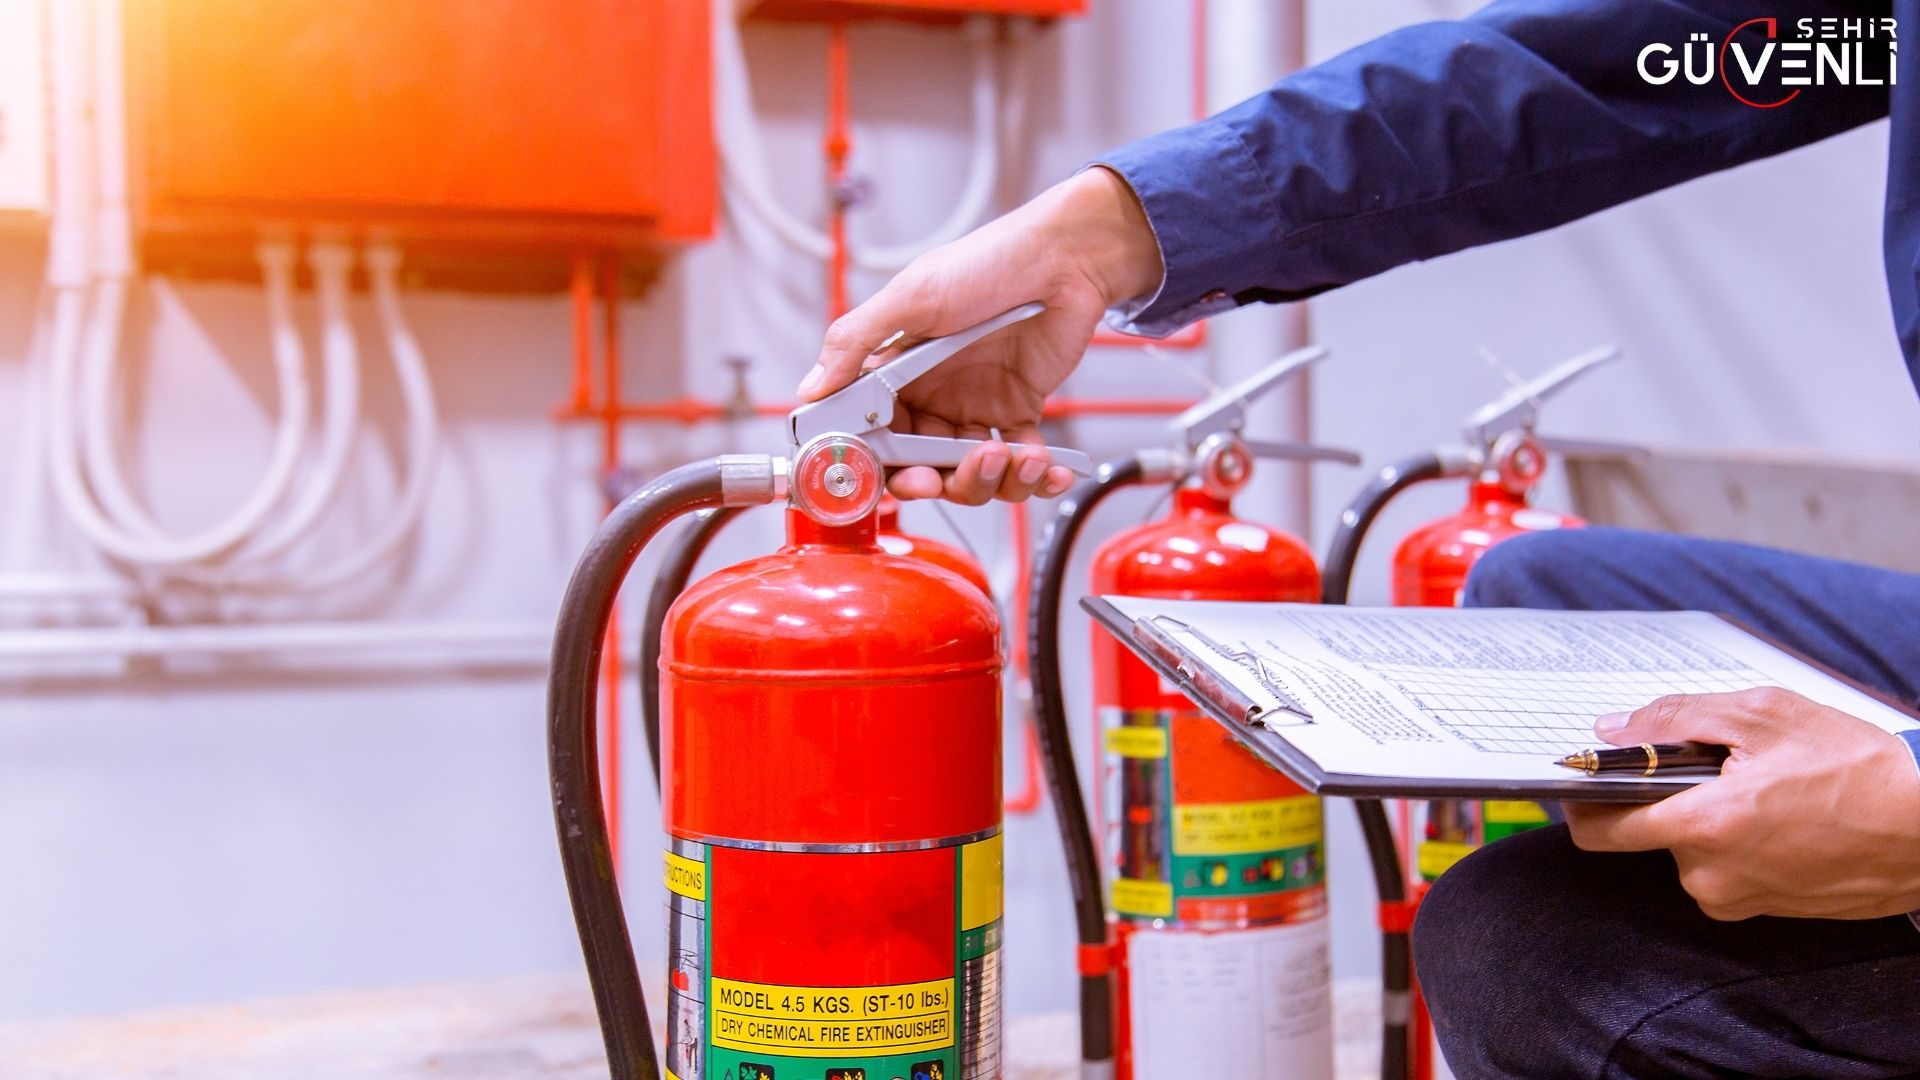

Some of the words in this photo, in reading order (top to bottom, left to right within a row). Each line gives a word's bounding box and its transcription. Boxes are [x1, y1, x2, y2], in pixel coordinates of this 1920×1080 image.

[720, 987, 775, 1011] MODEL
[781, 995, 805, 1012] 4.5
[813, 996, 854, 1013] KGS.
[863, 993, 915, 1017] (ST-10
[921, 987, 949, 1008] lbs.)
[721, 1017, 744, 1035] DRY
[747, 1022, 815, 1042] CHEMICAL
[820, 1027, 850, 1042] FIRE
[856, 1018, 946, 1042] EXTINGUISHER
